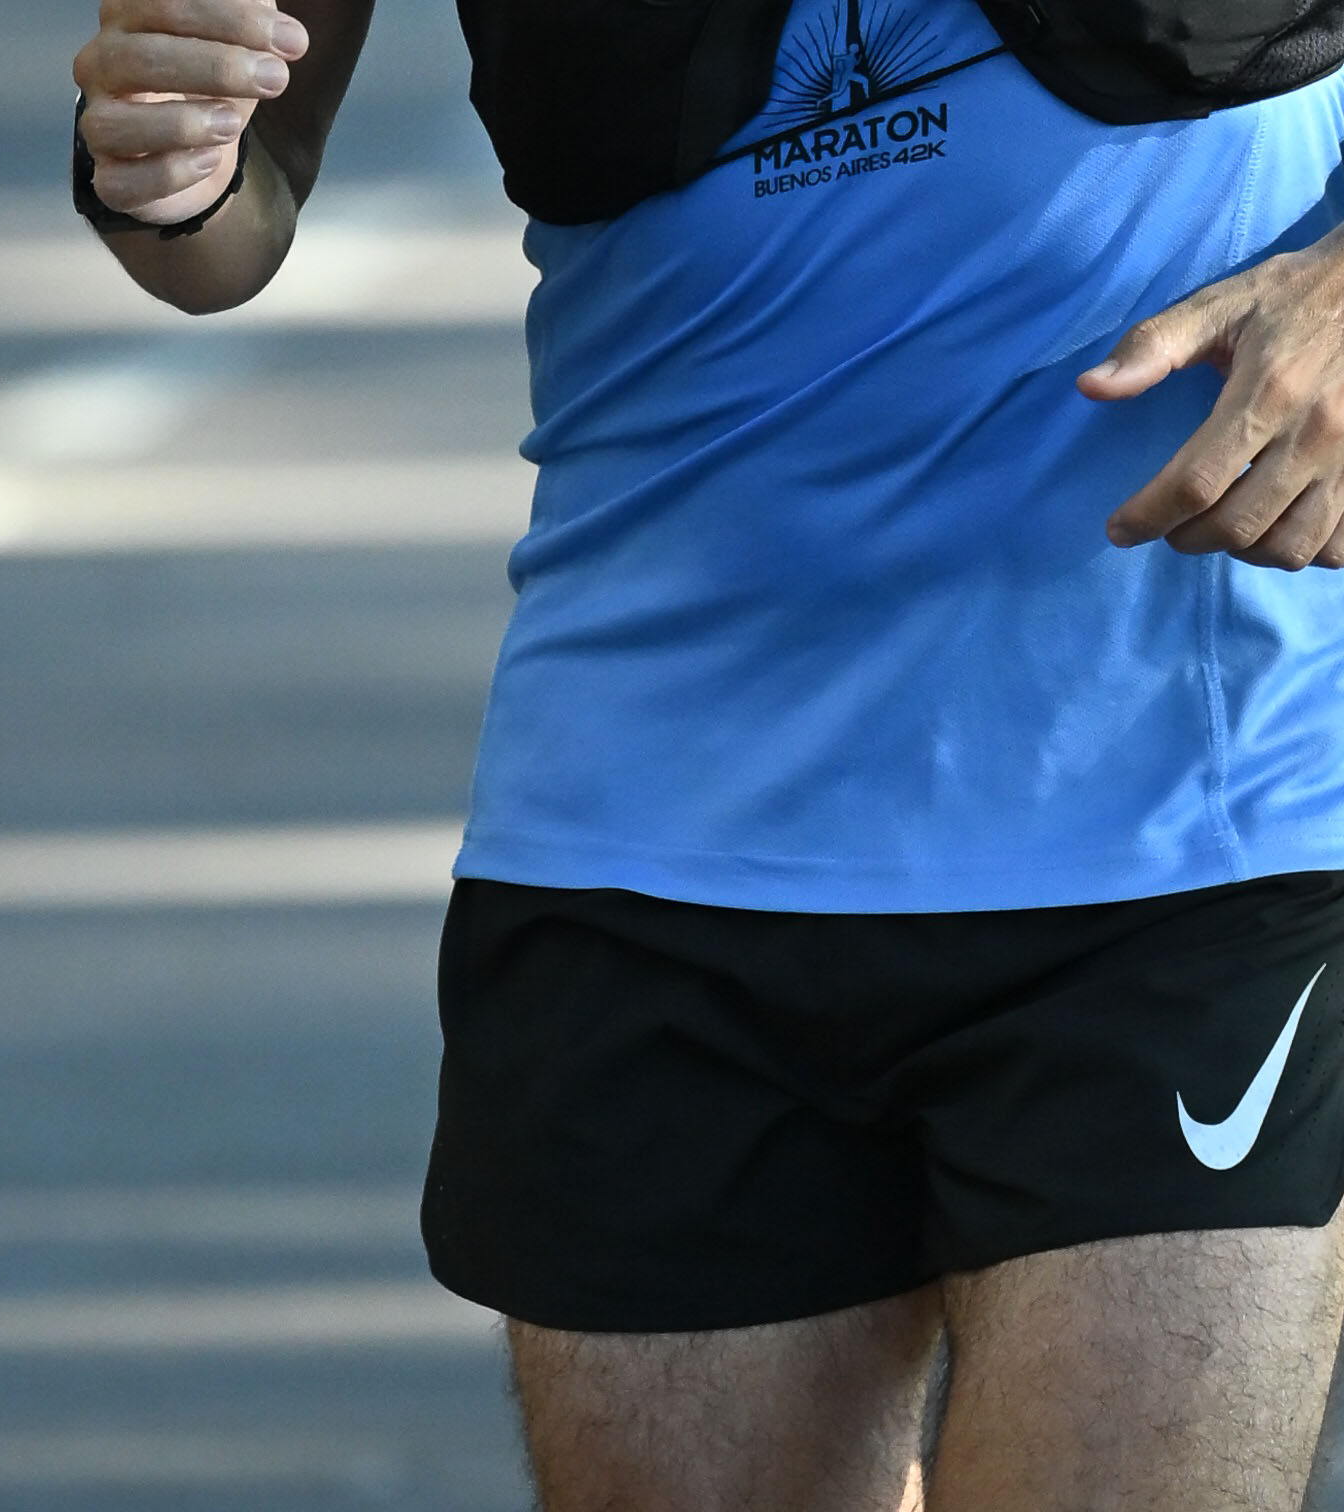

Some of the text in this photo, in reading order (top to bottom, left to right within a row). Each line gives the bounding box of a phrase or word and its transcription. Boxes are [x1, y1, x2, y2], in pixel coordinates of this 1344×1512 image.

[754, 103, 947, 174] MARATON
[755, 140, 946, 198] BUENOS AIRES 42K
